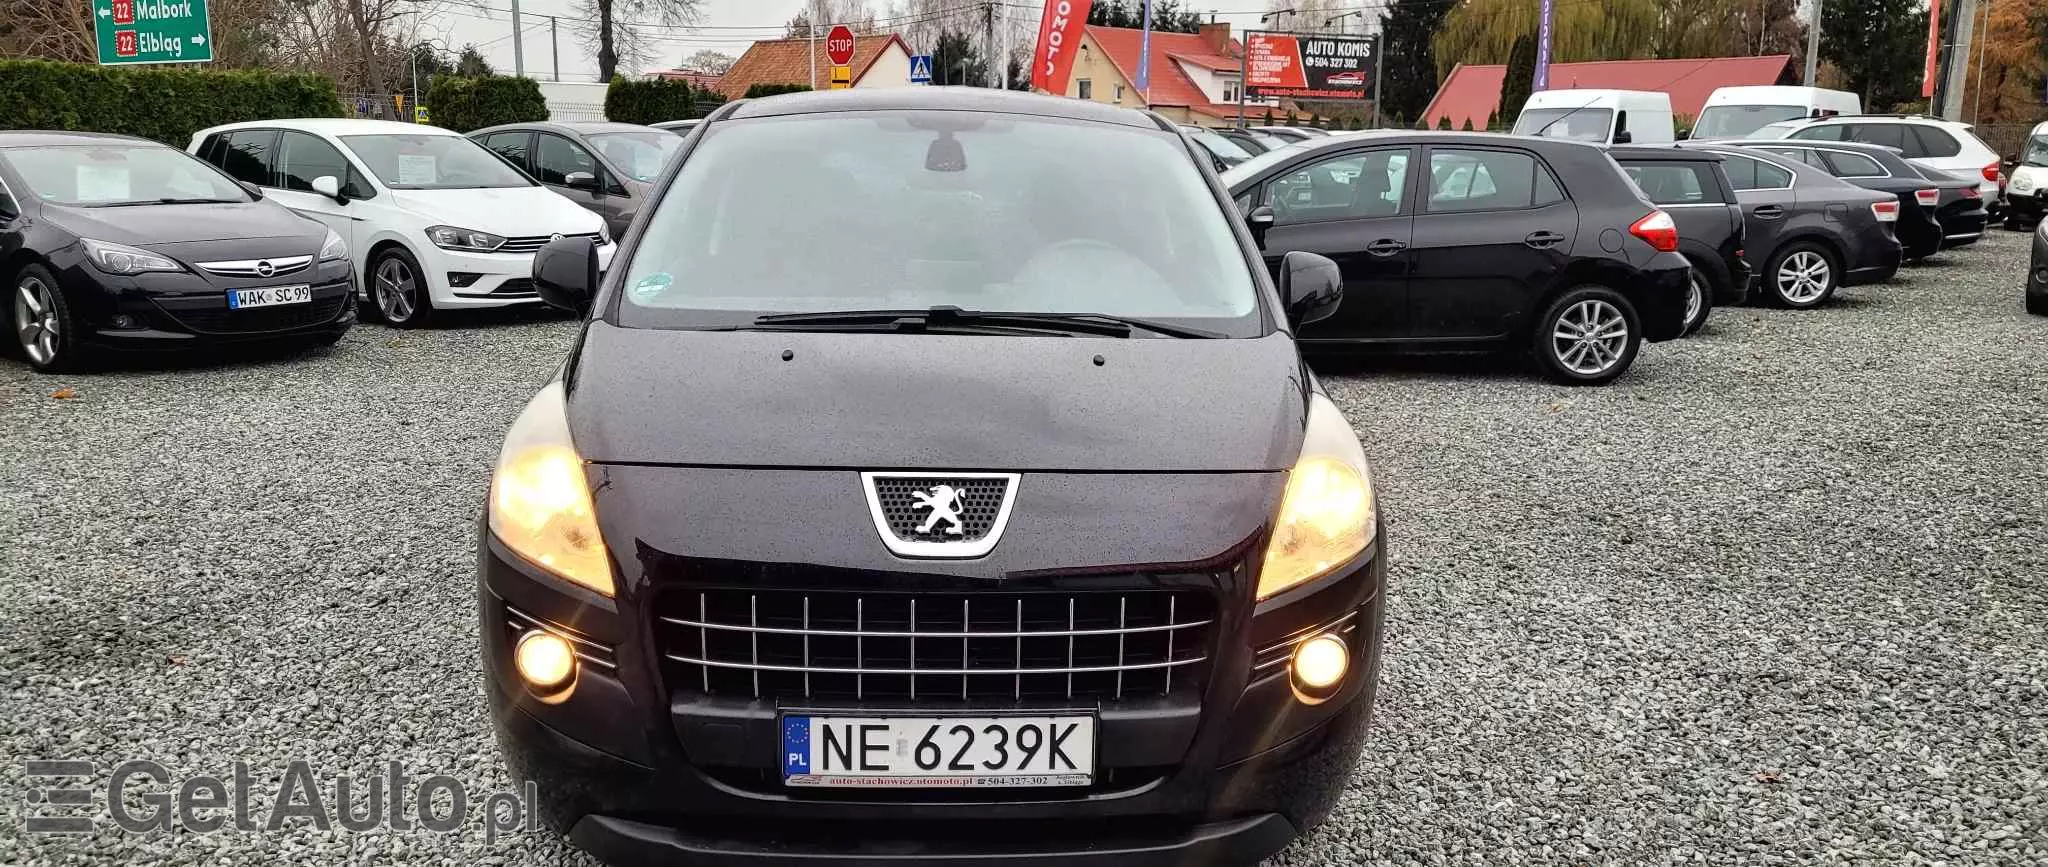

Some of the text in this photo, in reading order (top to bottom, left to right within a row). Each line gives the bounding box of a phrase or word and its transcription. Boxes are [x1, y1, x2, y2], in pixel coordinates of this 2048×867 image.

[116, 0, 192, 20] 22 Malbork
[120, 32, 182, 57] 22 Elbląg
[829, 39, 852, 52] STOP
[1306, 40, 1371, 57] AUTO KOMIS
[1314, 57, 1358, 69] 504 327 302
[238, 287, 309, 306] WAK SC 99
[822, 723, 1079, 770] NE 6239K
[788, 753, 807, 766] PL
